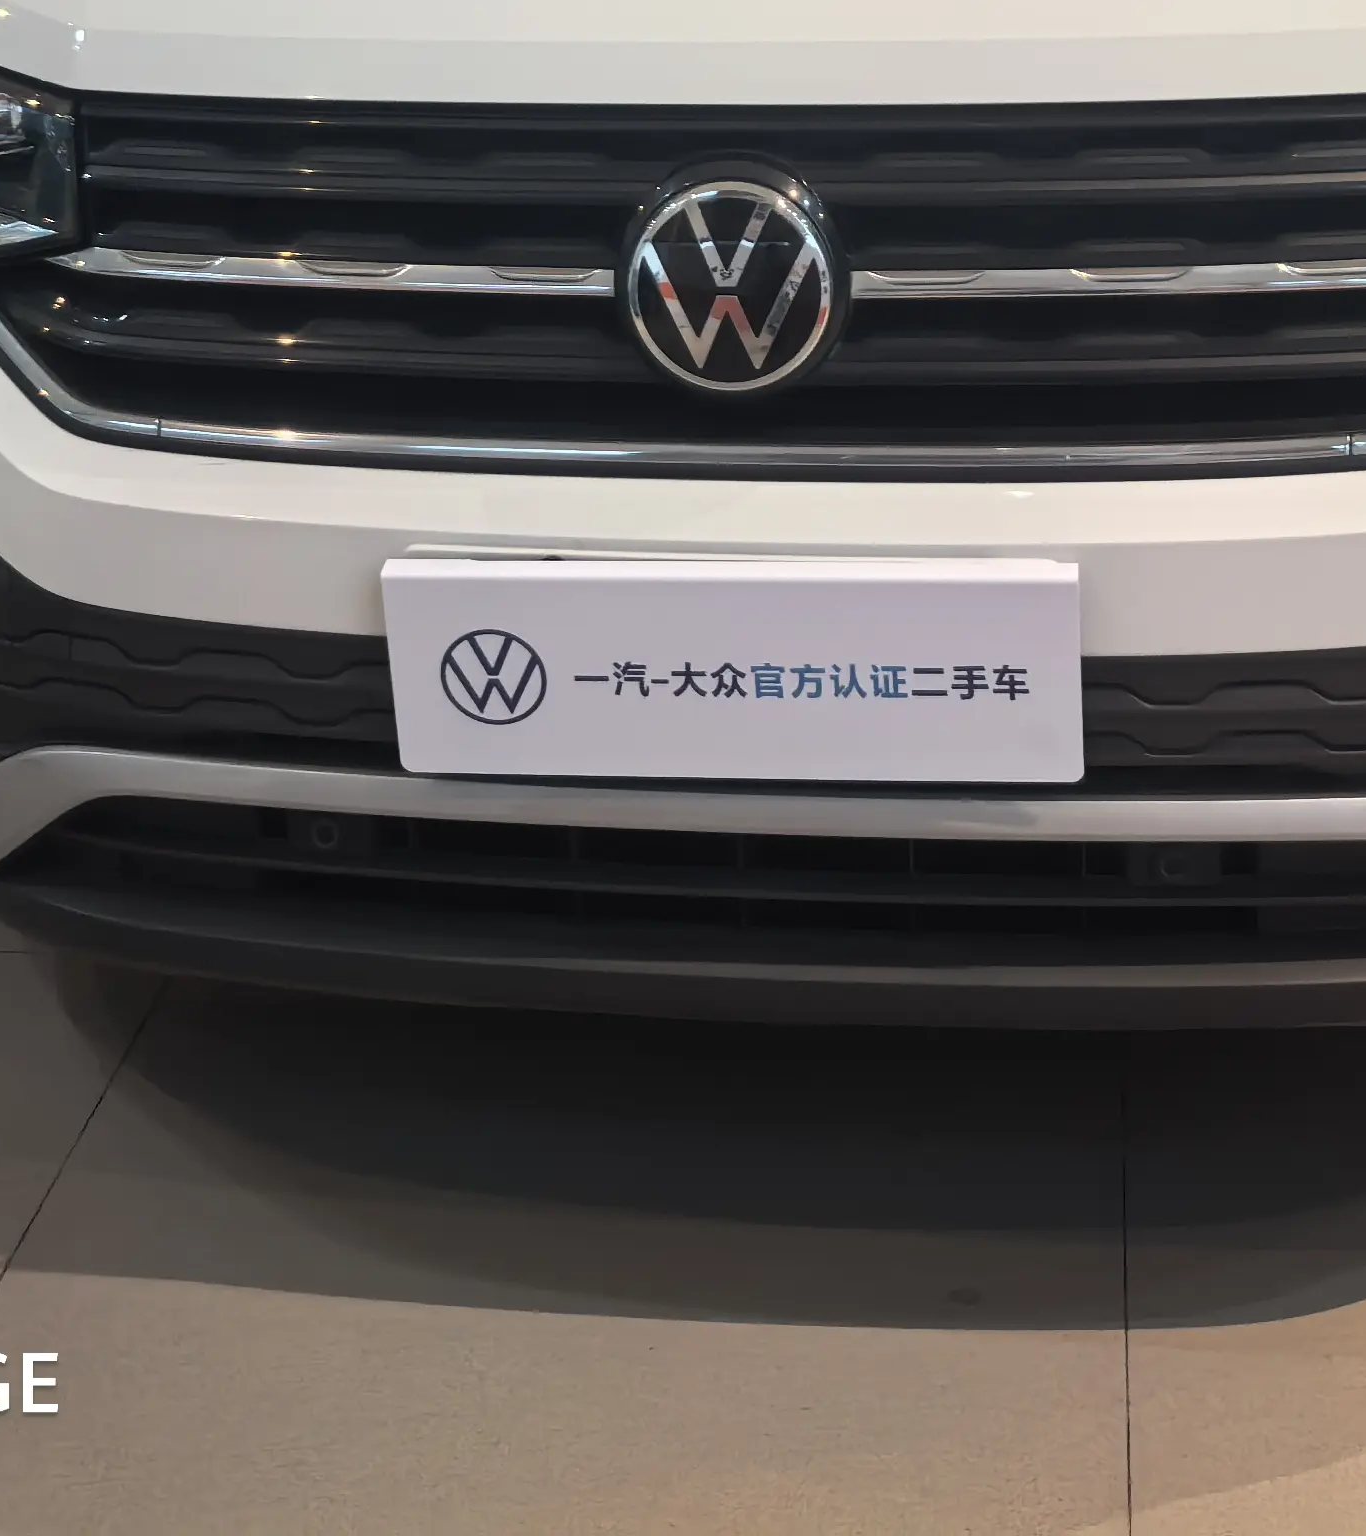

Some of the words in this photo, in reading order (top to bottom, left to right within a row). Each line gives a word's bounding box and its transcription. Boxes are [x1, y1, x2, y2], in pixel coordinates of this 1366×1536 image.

[573, 661, 1031, 702] 一汽-大众官方认证二手车
